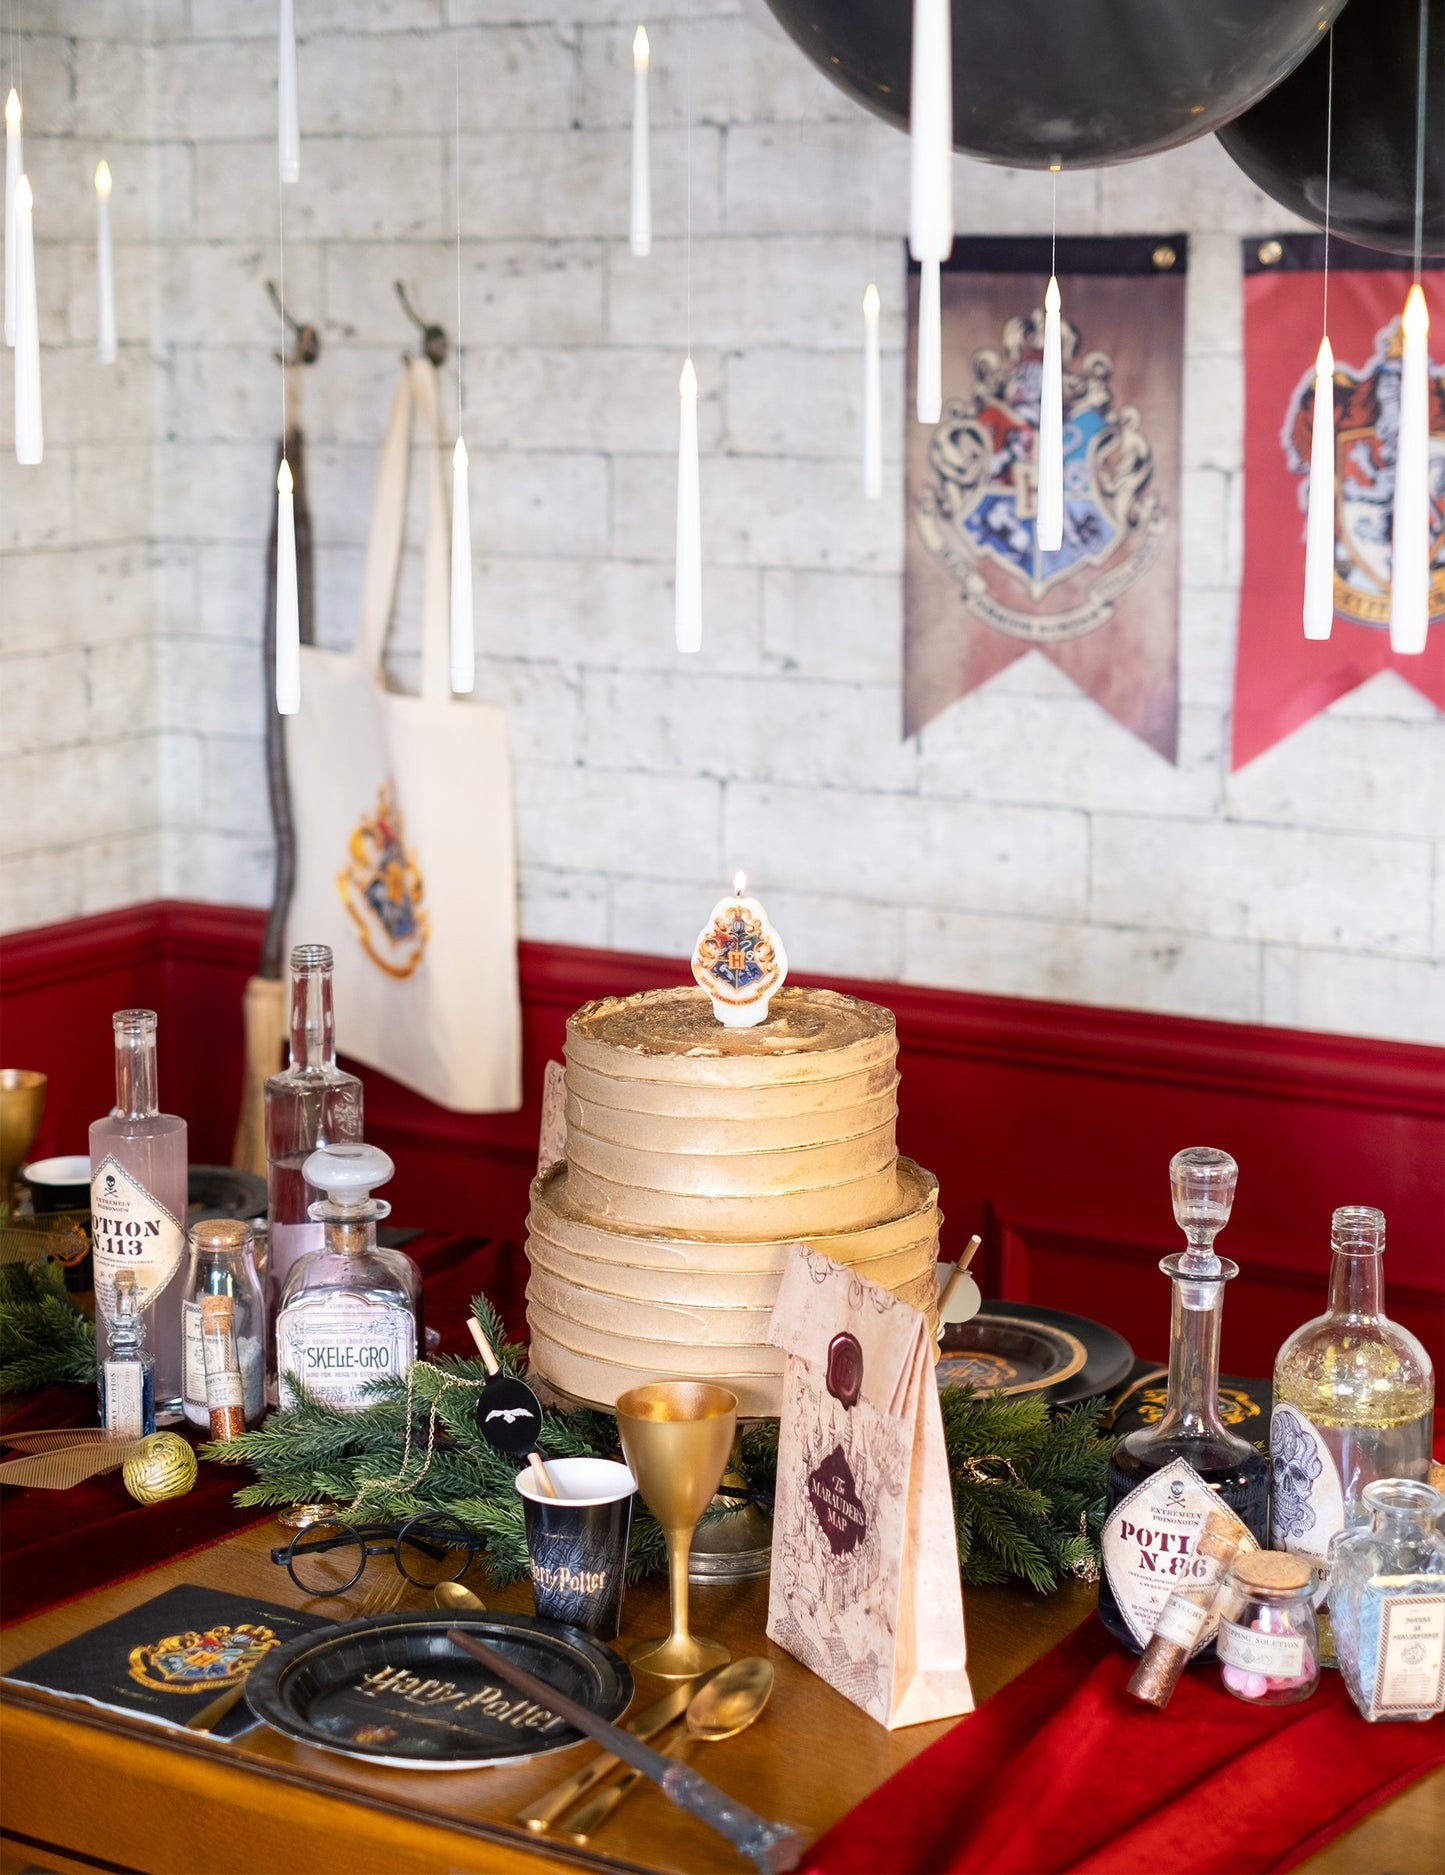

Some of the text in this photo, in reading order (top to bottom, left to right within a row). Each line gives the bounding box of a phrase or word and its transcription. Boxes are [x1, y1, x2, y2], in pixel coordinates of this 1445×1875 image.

[92, 1214, 161, 1237] OTION
[93, 1231, 143, 1256] N.113
[306, 1346, 389, 1369] SKELE-GRO
[827, 1507, 848, 1532] MAP
[1150, 1506, 1203, 1519] EXTREMELY
[1152, 1514, 1199, 1526] POISONOUS
[1119, 1519, 1192, 1555] POTI
[1138, 1549, 1208, 1578] N.86
[554, 1566, 607, 1594] Potter
[1255, 1638, 1300, 1649] SOLUTION
[354, 1664, 565, 1733] Harry Potter
